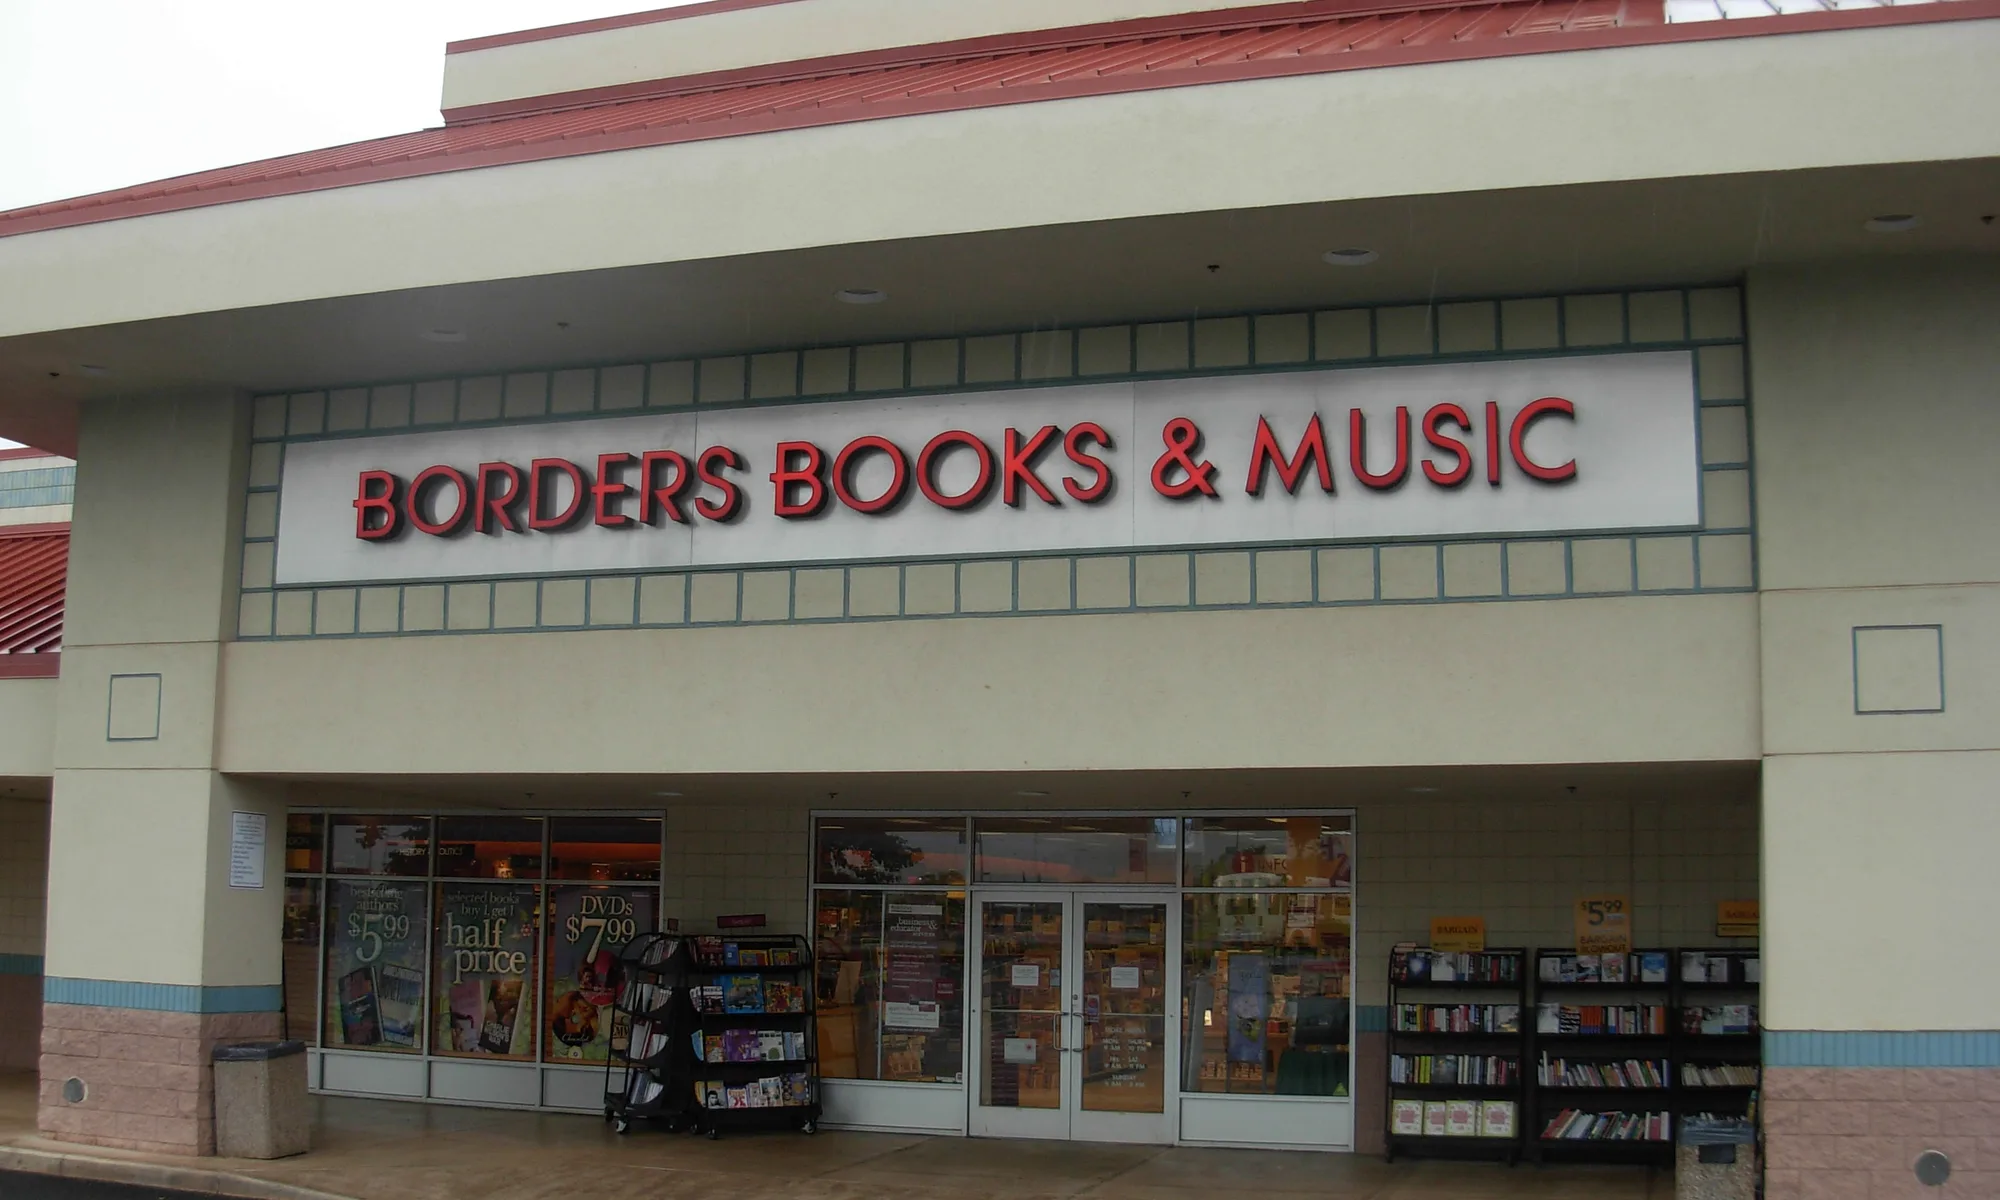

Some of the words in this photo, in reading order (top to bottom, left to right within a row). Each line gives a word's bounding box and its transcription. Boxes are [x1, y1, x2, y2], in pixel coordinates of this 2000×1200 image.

[353, 445, 742, 540] BORDERS
[769, 421, 1111, 518] BOOKS
[1151, 417, 1219, 499] &
[1245, 397, 1577, 497] MUSIC
[356, 898, 400, 912] authors
[448, 891, 488, 904] selected
[490, 892, 520, 905] books
[460, 903, 480, 920] buy
[492, 906, 508, 919] get
[580, 895, 634, 917] DVDs
[445, 912, 507, 949] half
[890, 923, 922, 932] educator
[1436, 926, 1478, 934] BARGAIN
[1580, 935, 1627, 944] BARGAIN
[453, 949, 527, 984] price
